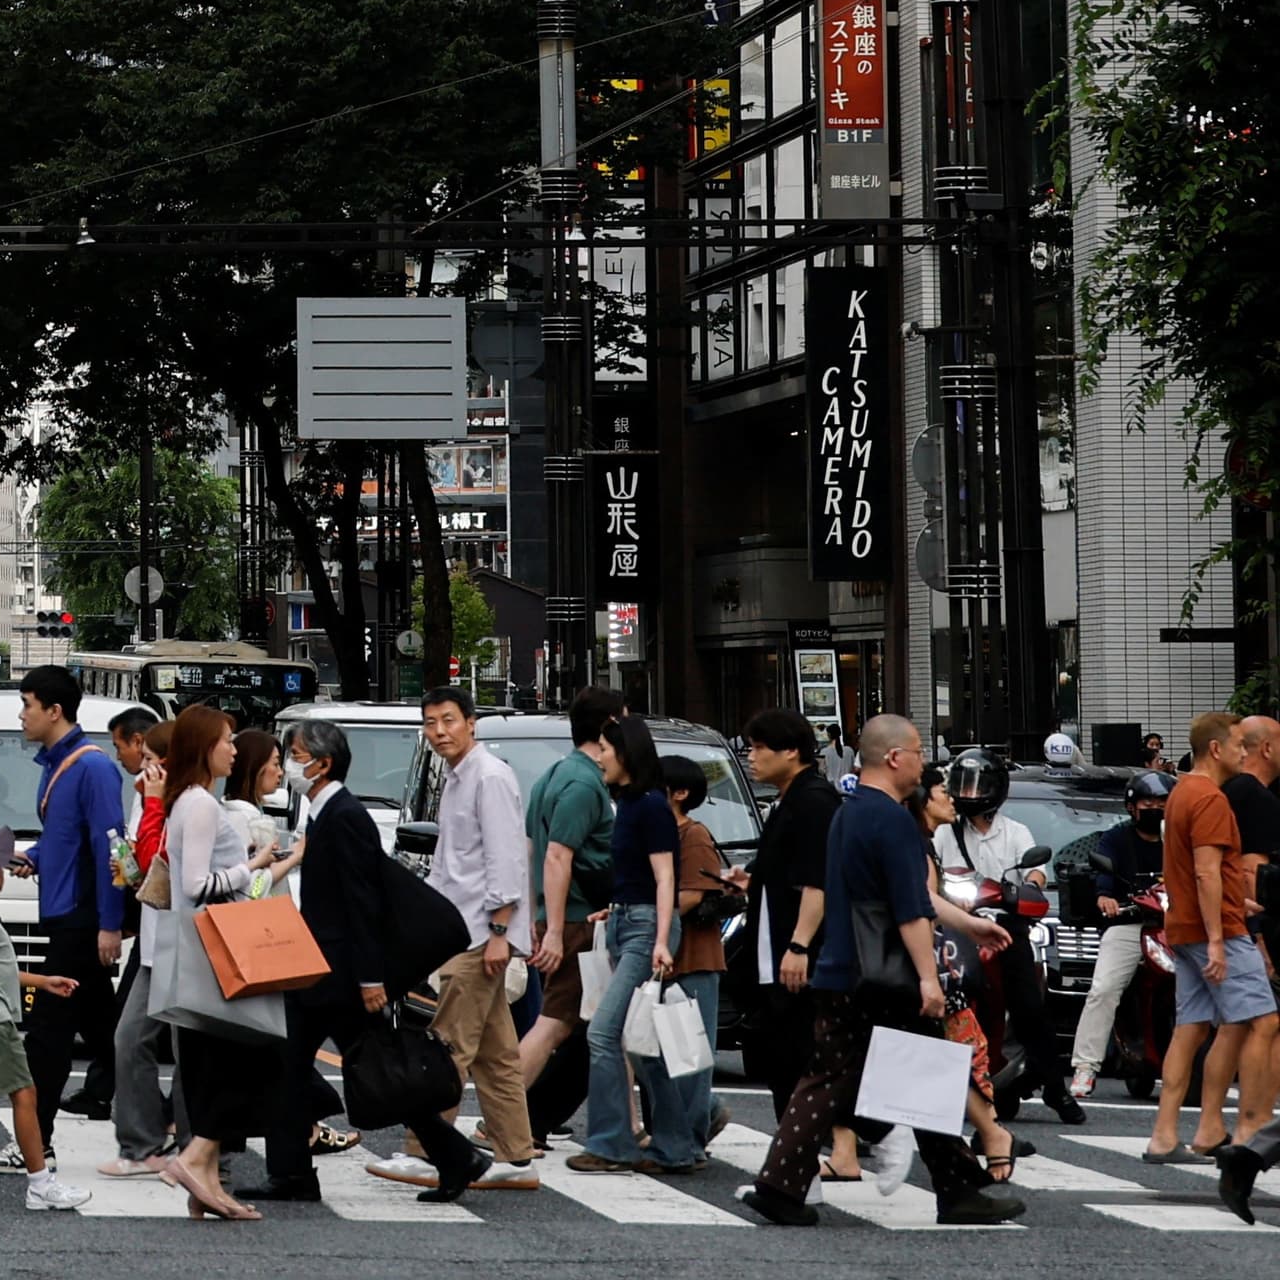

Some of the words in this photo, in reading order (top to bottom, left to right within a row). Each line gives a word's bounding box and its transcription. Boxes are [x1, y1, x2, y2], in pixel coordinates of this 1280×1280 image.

[829, 21, 850, 111] ステーキ
[852, 3, 876, 75] 銀座の
[838, 129, 873, 144] B1F
[830, 174, 881, 190] 銀座幸ビル
[614, 417, 630, 452] 銀座
[821, 366, 844, 545] CAMERA
[848, 290, 872, 558] KATSUMIDO
[606, 466, 640, 577] 山形屋
